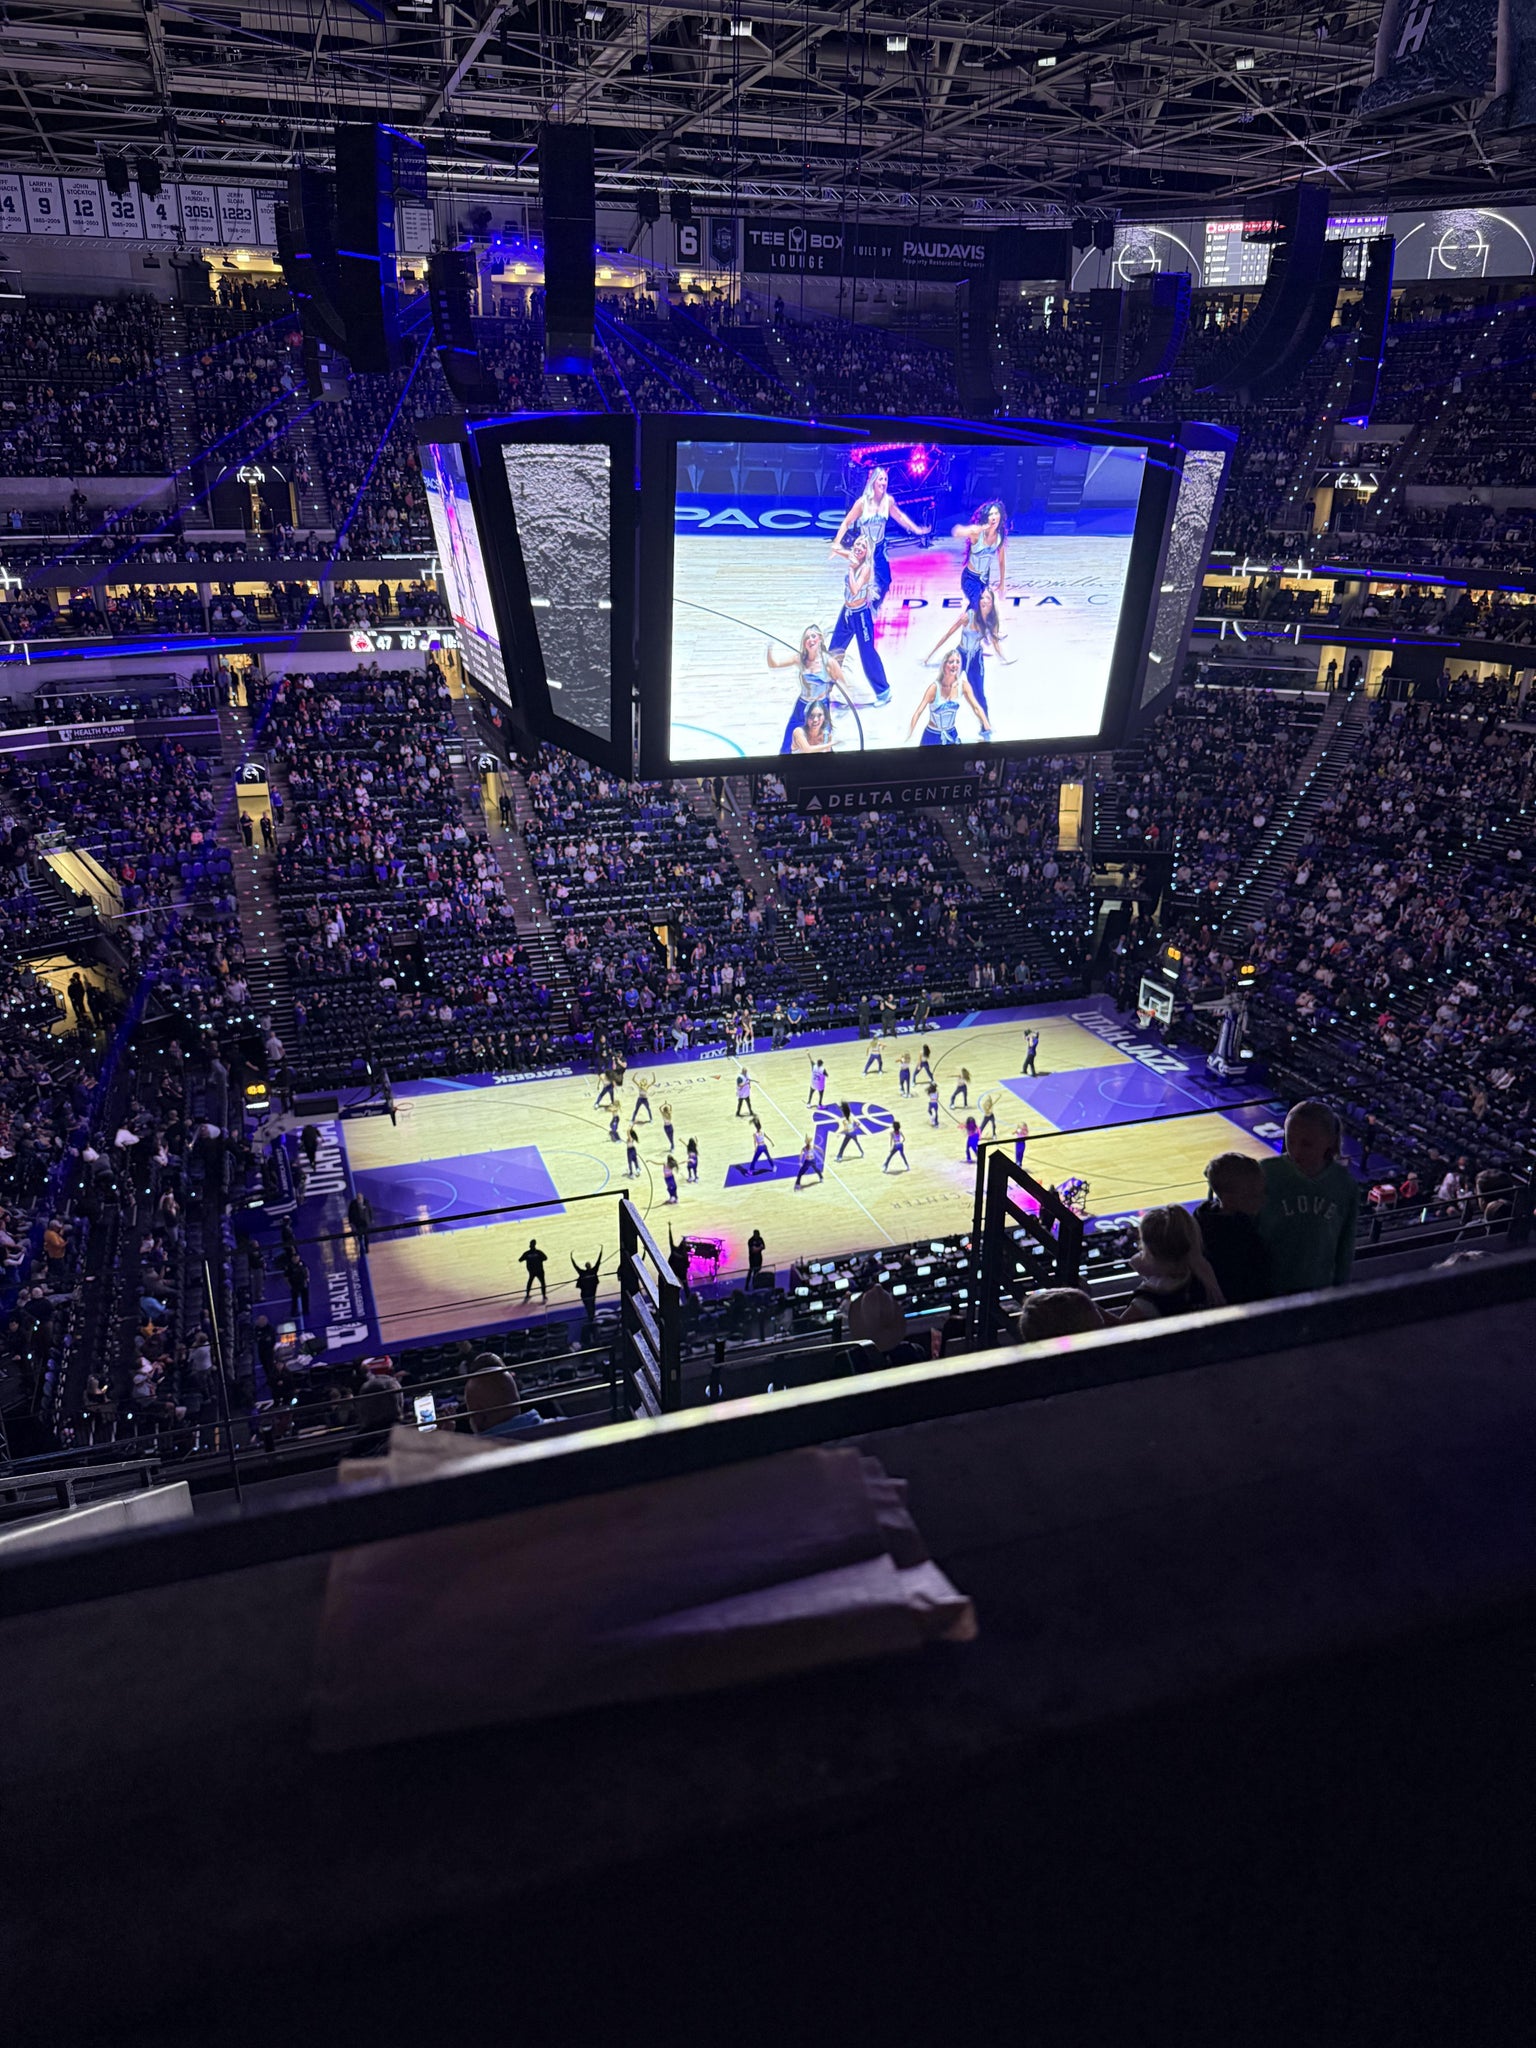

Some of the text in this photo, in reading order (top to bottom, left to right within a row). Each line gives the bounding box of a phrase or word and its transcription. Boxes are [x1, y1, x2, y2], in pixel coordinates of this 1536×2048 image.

[38, 197, 51, 215] 9
[73, 199, 94, 217] 12
[110, 201, 135, 219] 32
[156, 203, 167, 220] 4
[184, 205, 214, 219] 3051
[222, 207, 252, 220] 1223
[680, 226, 697, 255] 6
[749, 230, 785, 246] TEE
[810, 234, 844, 249] BOX
[853, 244, 877, 257] UILT
[771, 253, 824, 269] LOUNGE
[901, 595, 1063, 610] DETA
[376, 634, 392, 650] 47
[400, 634, 416, 650] 78
[74, 727, 100, 737] HEALTH
[102, 725, 125, 734] PLANS
[828, 784, 973, 808] DELTA CENTER
[1071, 1010, 1190, 1075] UTAH JAZZ
[493, 1066, 573, 1085] SEATGEEK
[300, 1148, 346, 1196] UTAH
[893, 1192, 961, 1209] CENTER
[1281, 1195, 1337, 1220] LOVE
[327, 1271, 353, 1321] HEALTH
